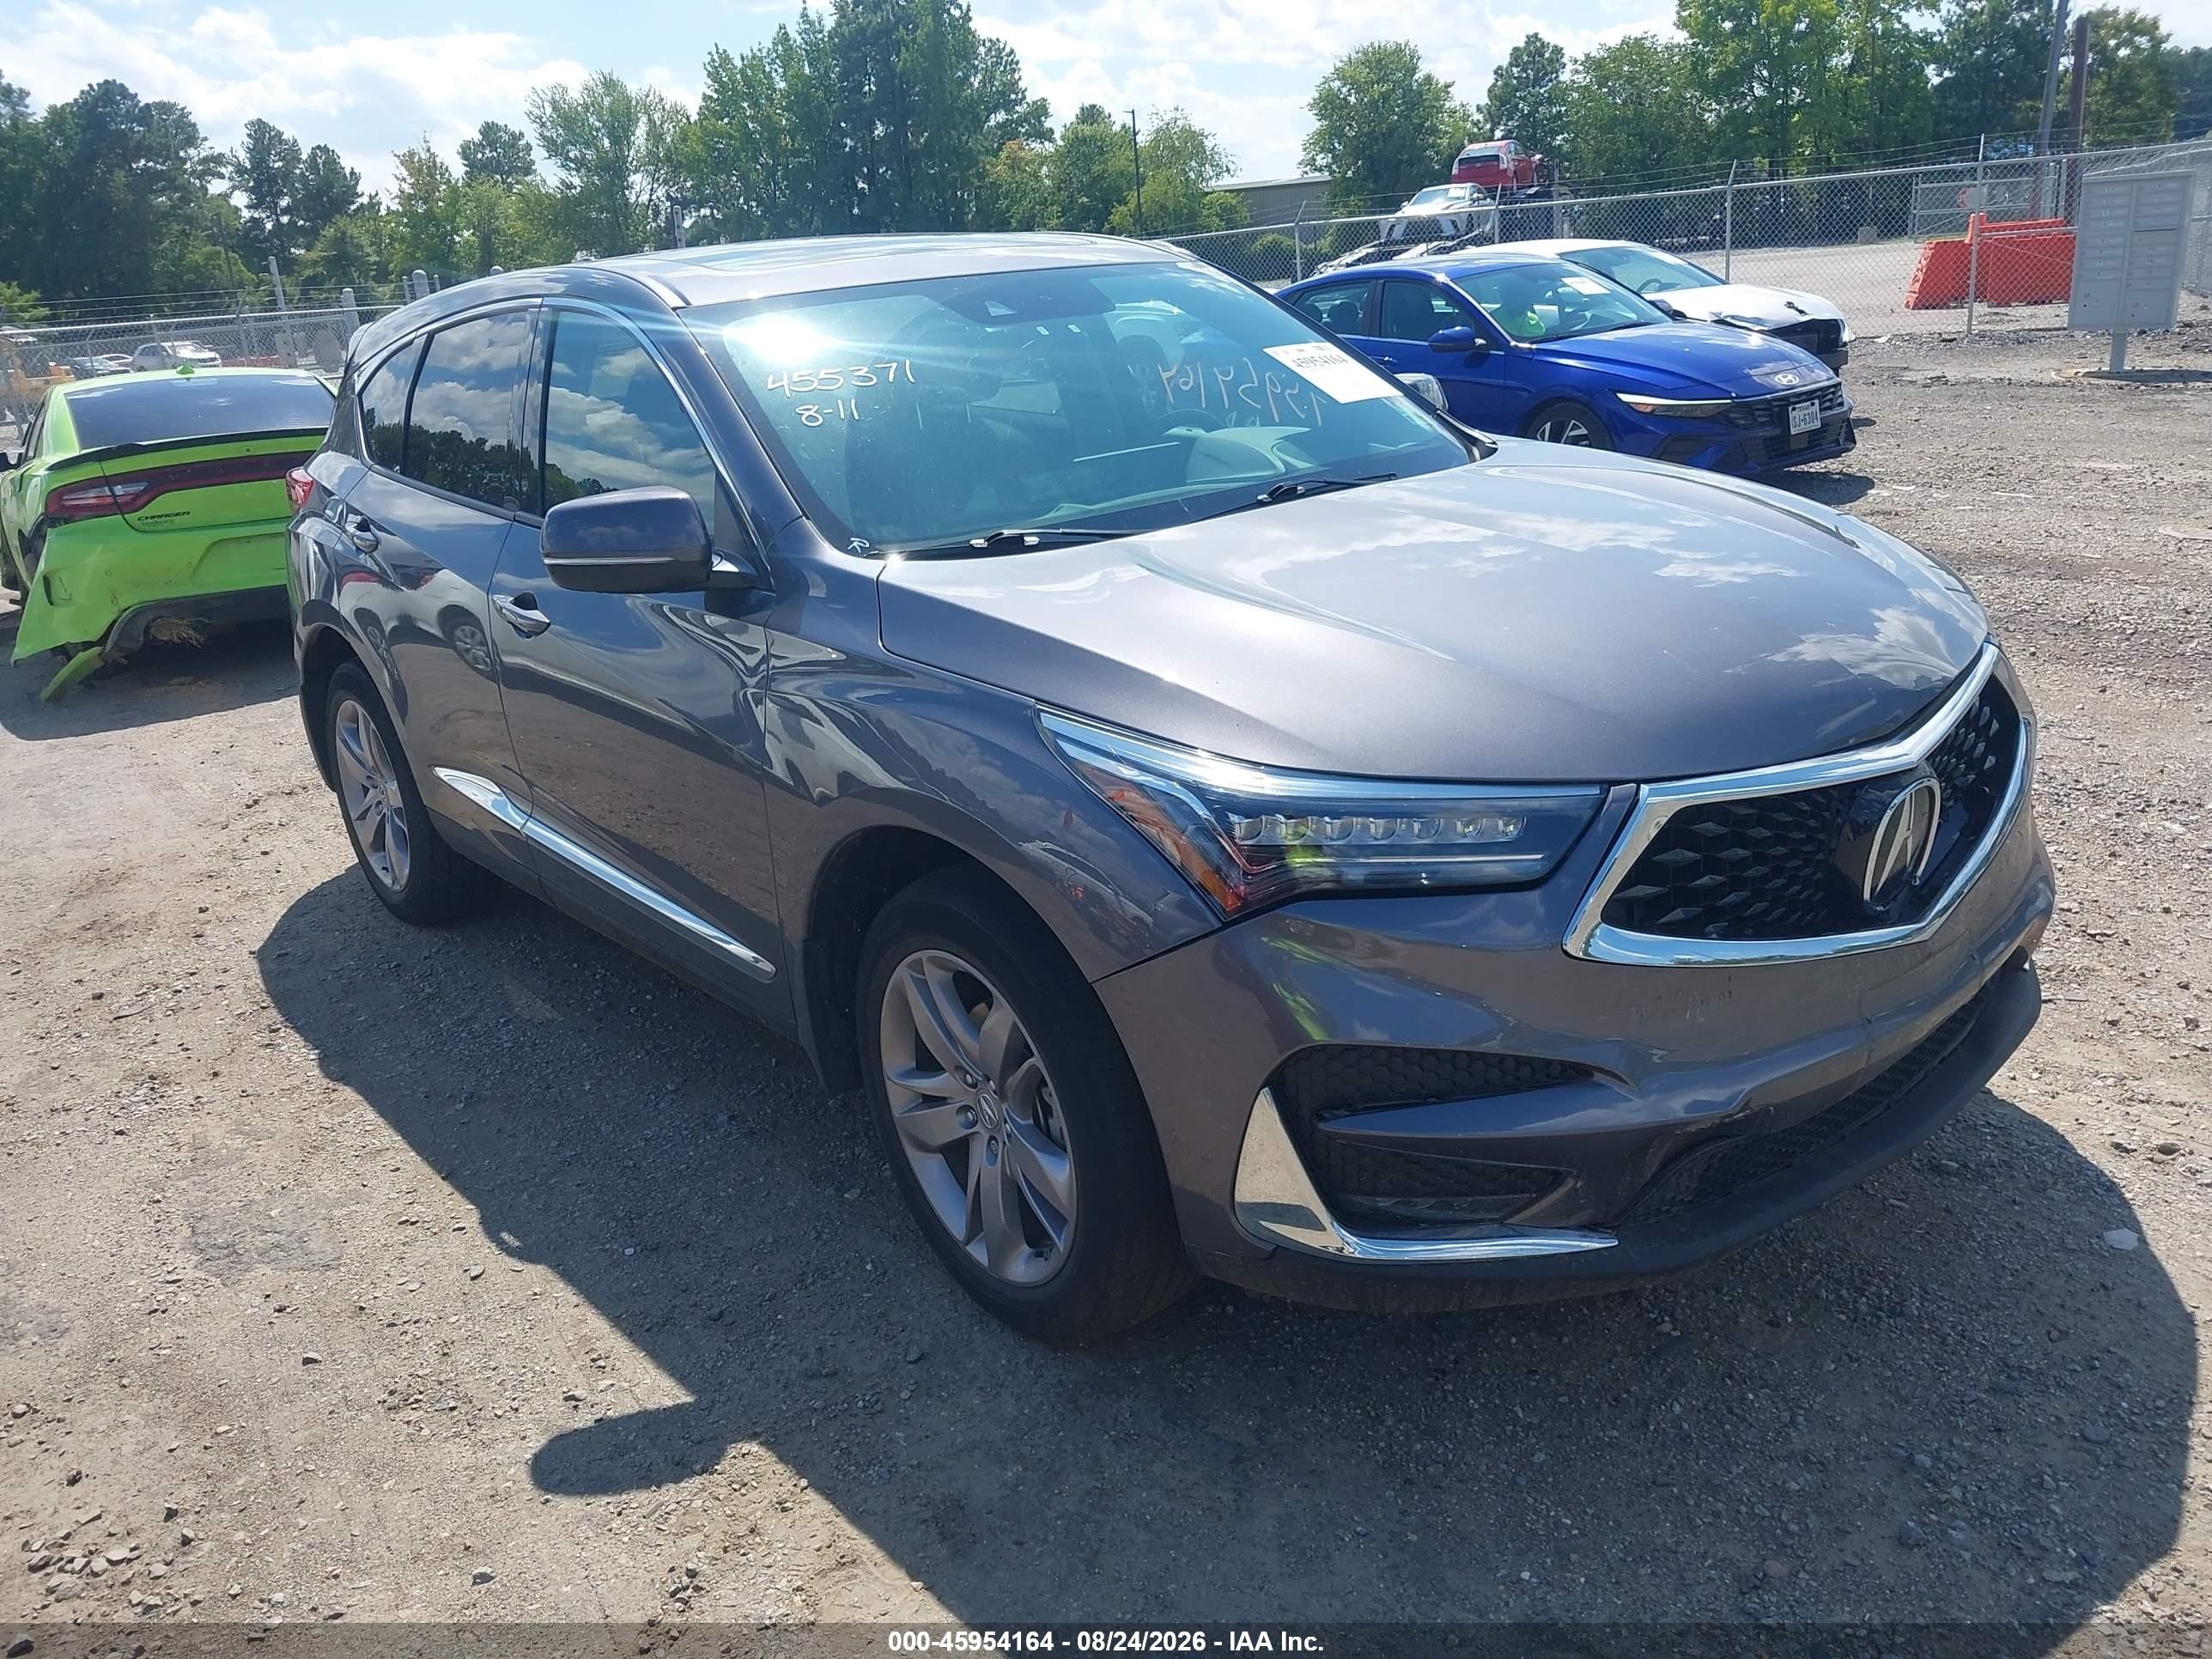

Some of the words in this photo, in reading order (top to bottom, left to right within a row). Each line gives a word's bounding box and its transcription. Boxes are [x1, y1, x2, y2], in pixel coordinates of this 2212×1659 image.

[766, 358, 915, 398] 455371
[795, 398, 860, 428] 8-11
[137, 511, 191, 520] CHARGER
